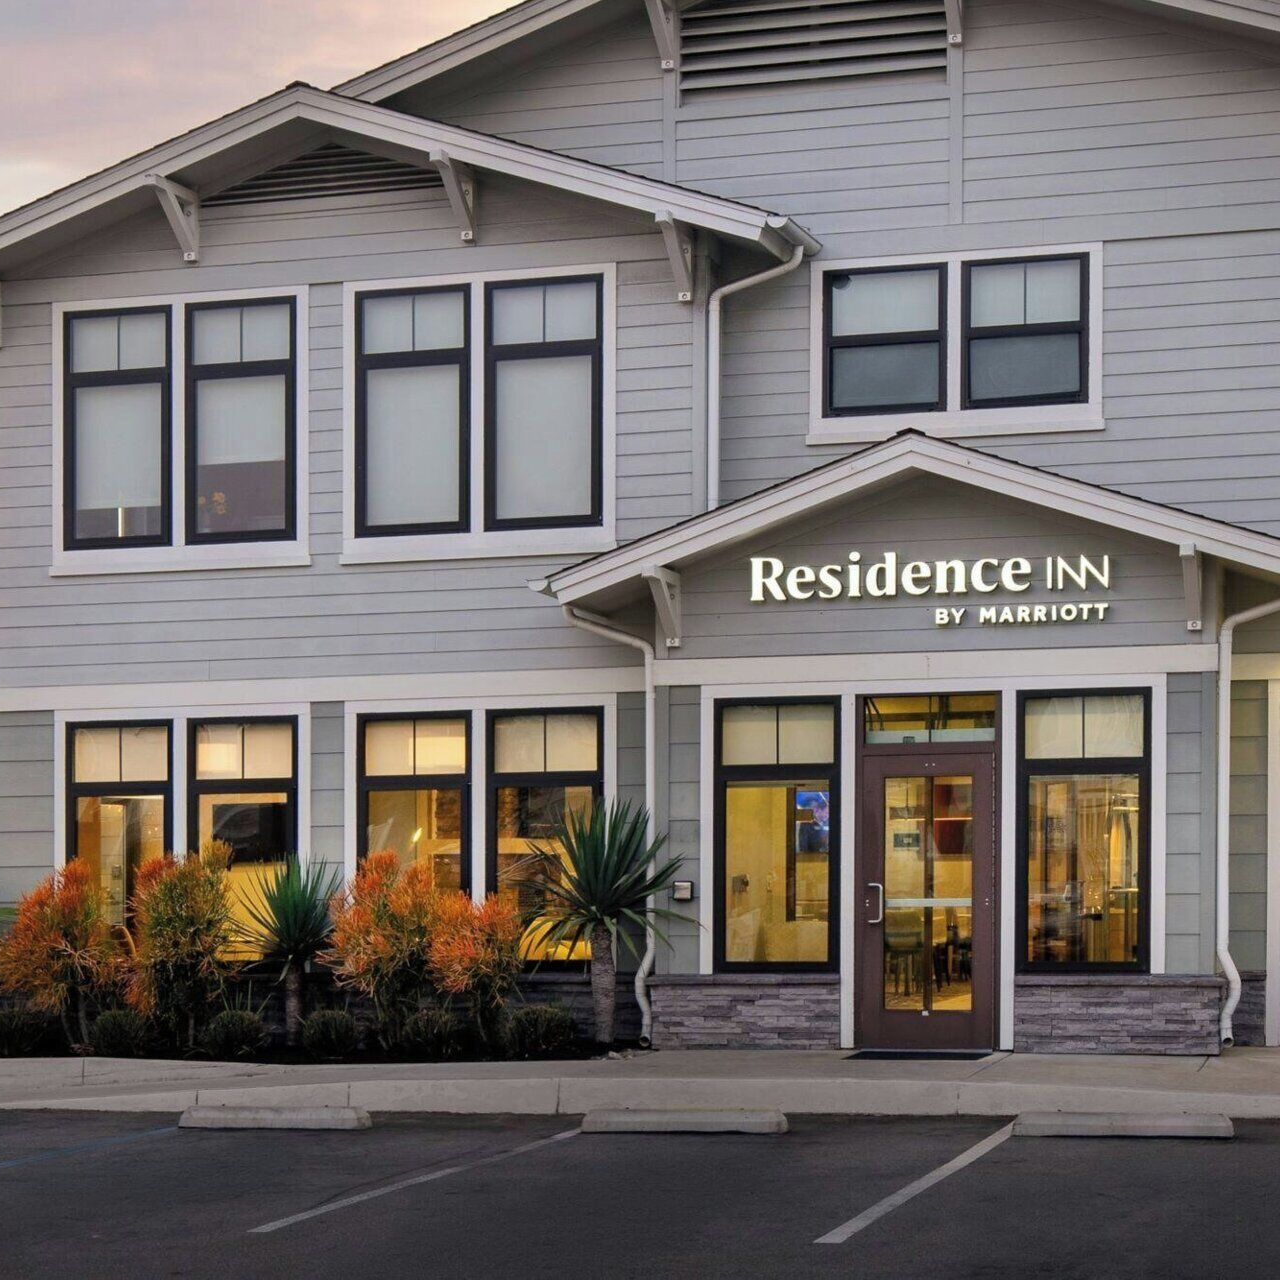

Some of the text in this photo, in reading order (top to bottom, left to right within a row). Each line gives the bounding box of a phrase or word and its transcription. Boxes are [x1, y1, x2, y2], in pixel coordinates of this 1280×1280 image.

[749, 551, 1111, 602] Residence INN
[934, 603, 1111, 626] BY MARRIOTT
